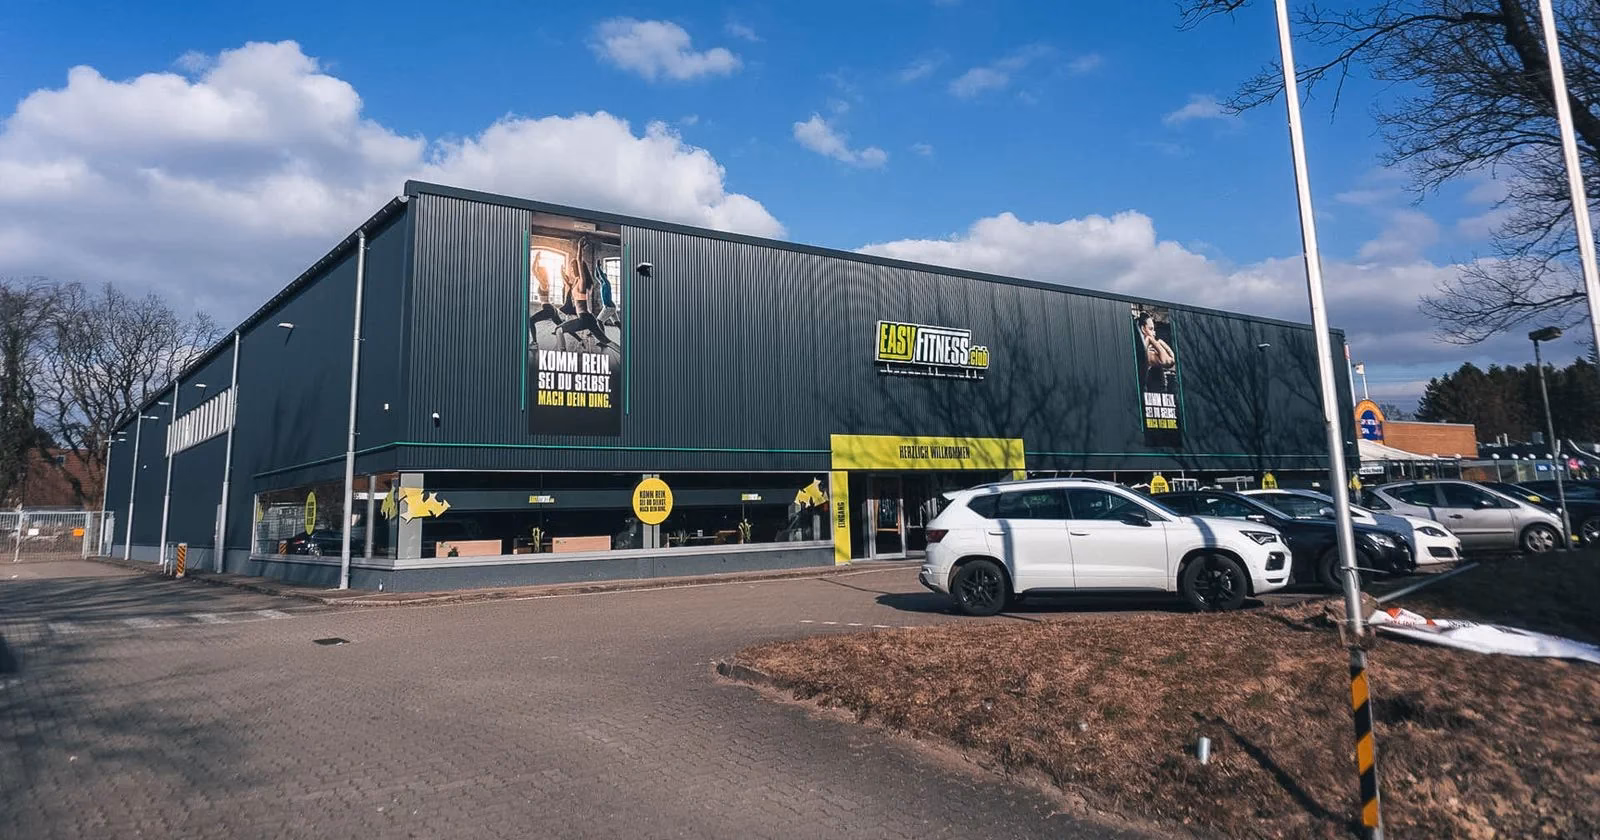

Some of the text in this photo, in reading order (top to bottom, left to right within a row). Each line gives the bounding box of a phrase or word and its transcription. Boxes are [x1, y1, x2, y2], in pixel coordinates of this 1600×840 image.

[880, 324, 916, 360] EASY
[916, 328, 970, 366] FITNESS
[539, 350, 611, 375] KOMM REIN.
[538, 372, 611, 393] SEI DU SELBST.
[538, 390, 611, 409] MACH DEIN DING.
[899, 445, 971, 459] HERZLICH WILLKOMMEN
[640, 490, 655, 499] KOMM
[837, 501, 846, 529] EINGANG
